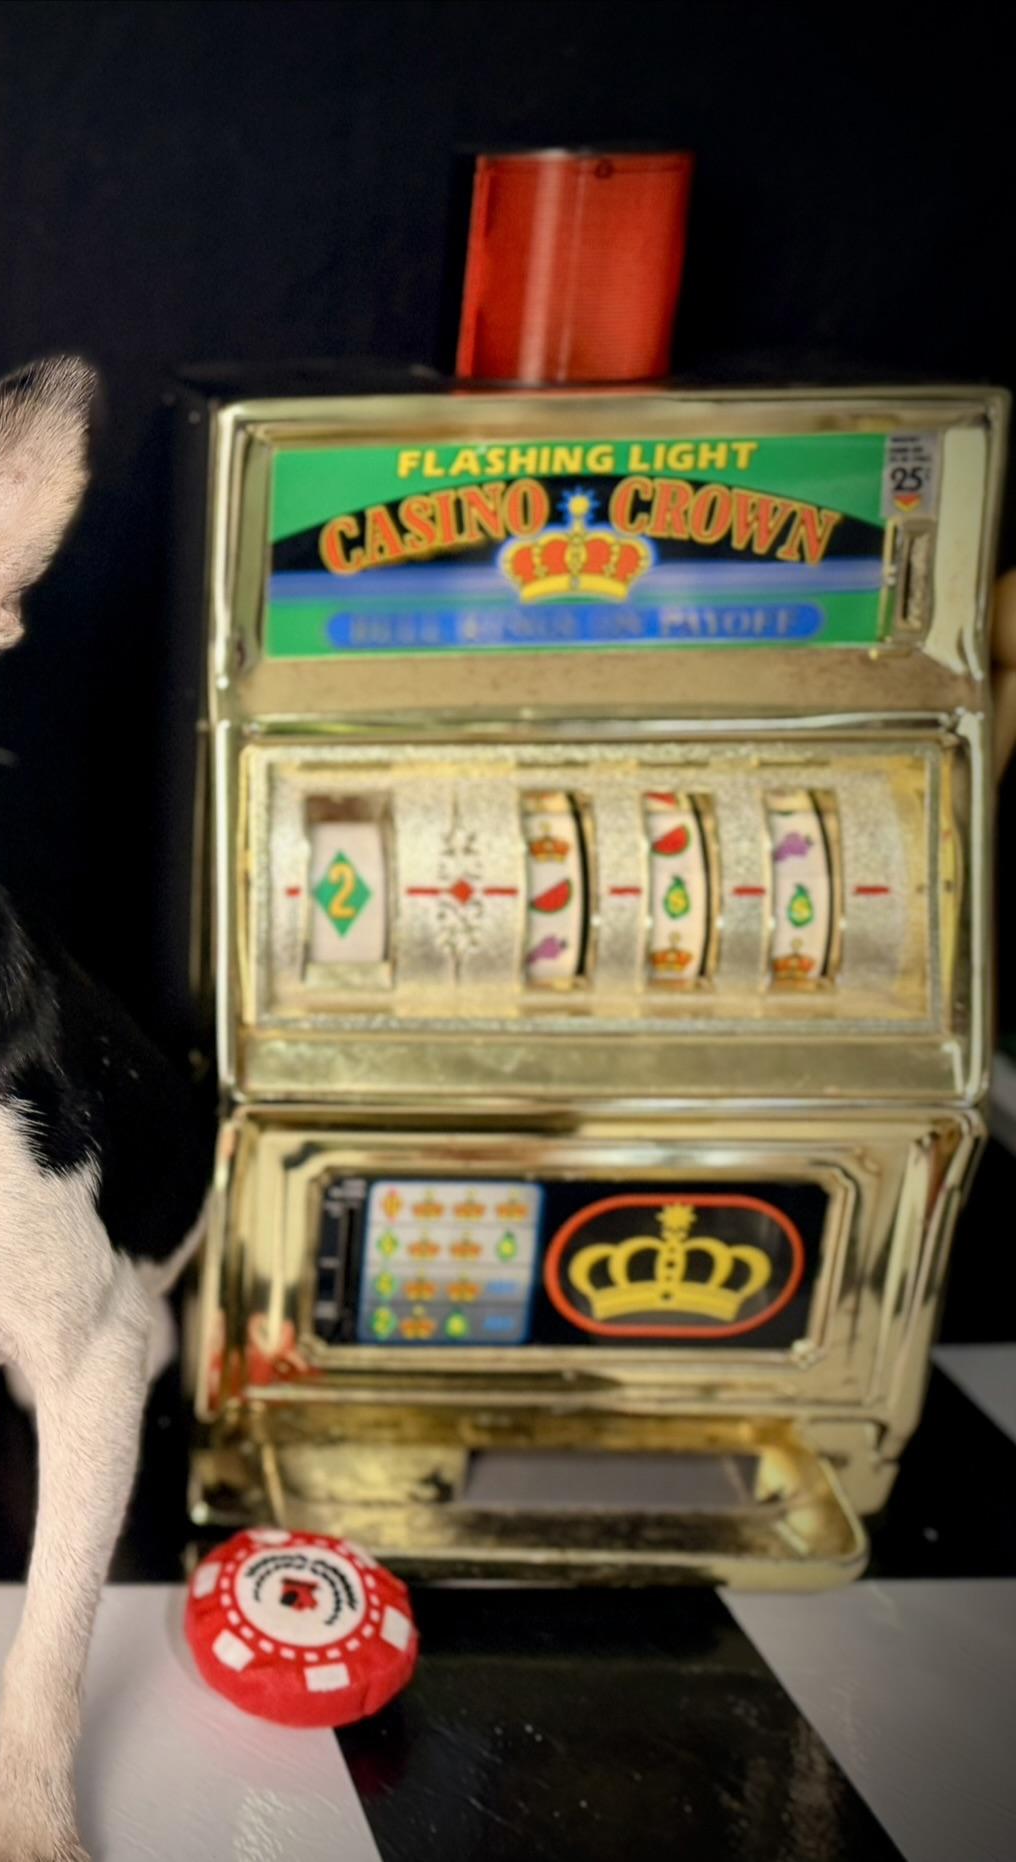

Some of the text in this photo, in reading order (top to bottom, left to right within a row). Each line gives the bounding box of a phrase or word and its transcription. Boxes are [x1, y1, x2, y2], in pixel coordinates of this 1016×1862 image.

[396, 441, 758, 479] FLASHING LIGHT
[318, 475, 843, 576] CASINO CROWN
[327, 862, 358, 920] 2
